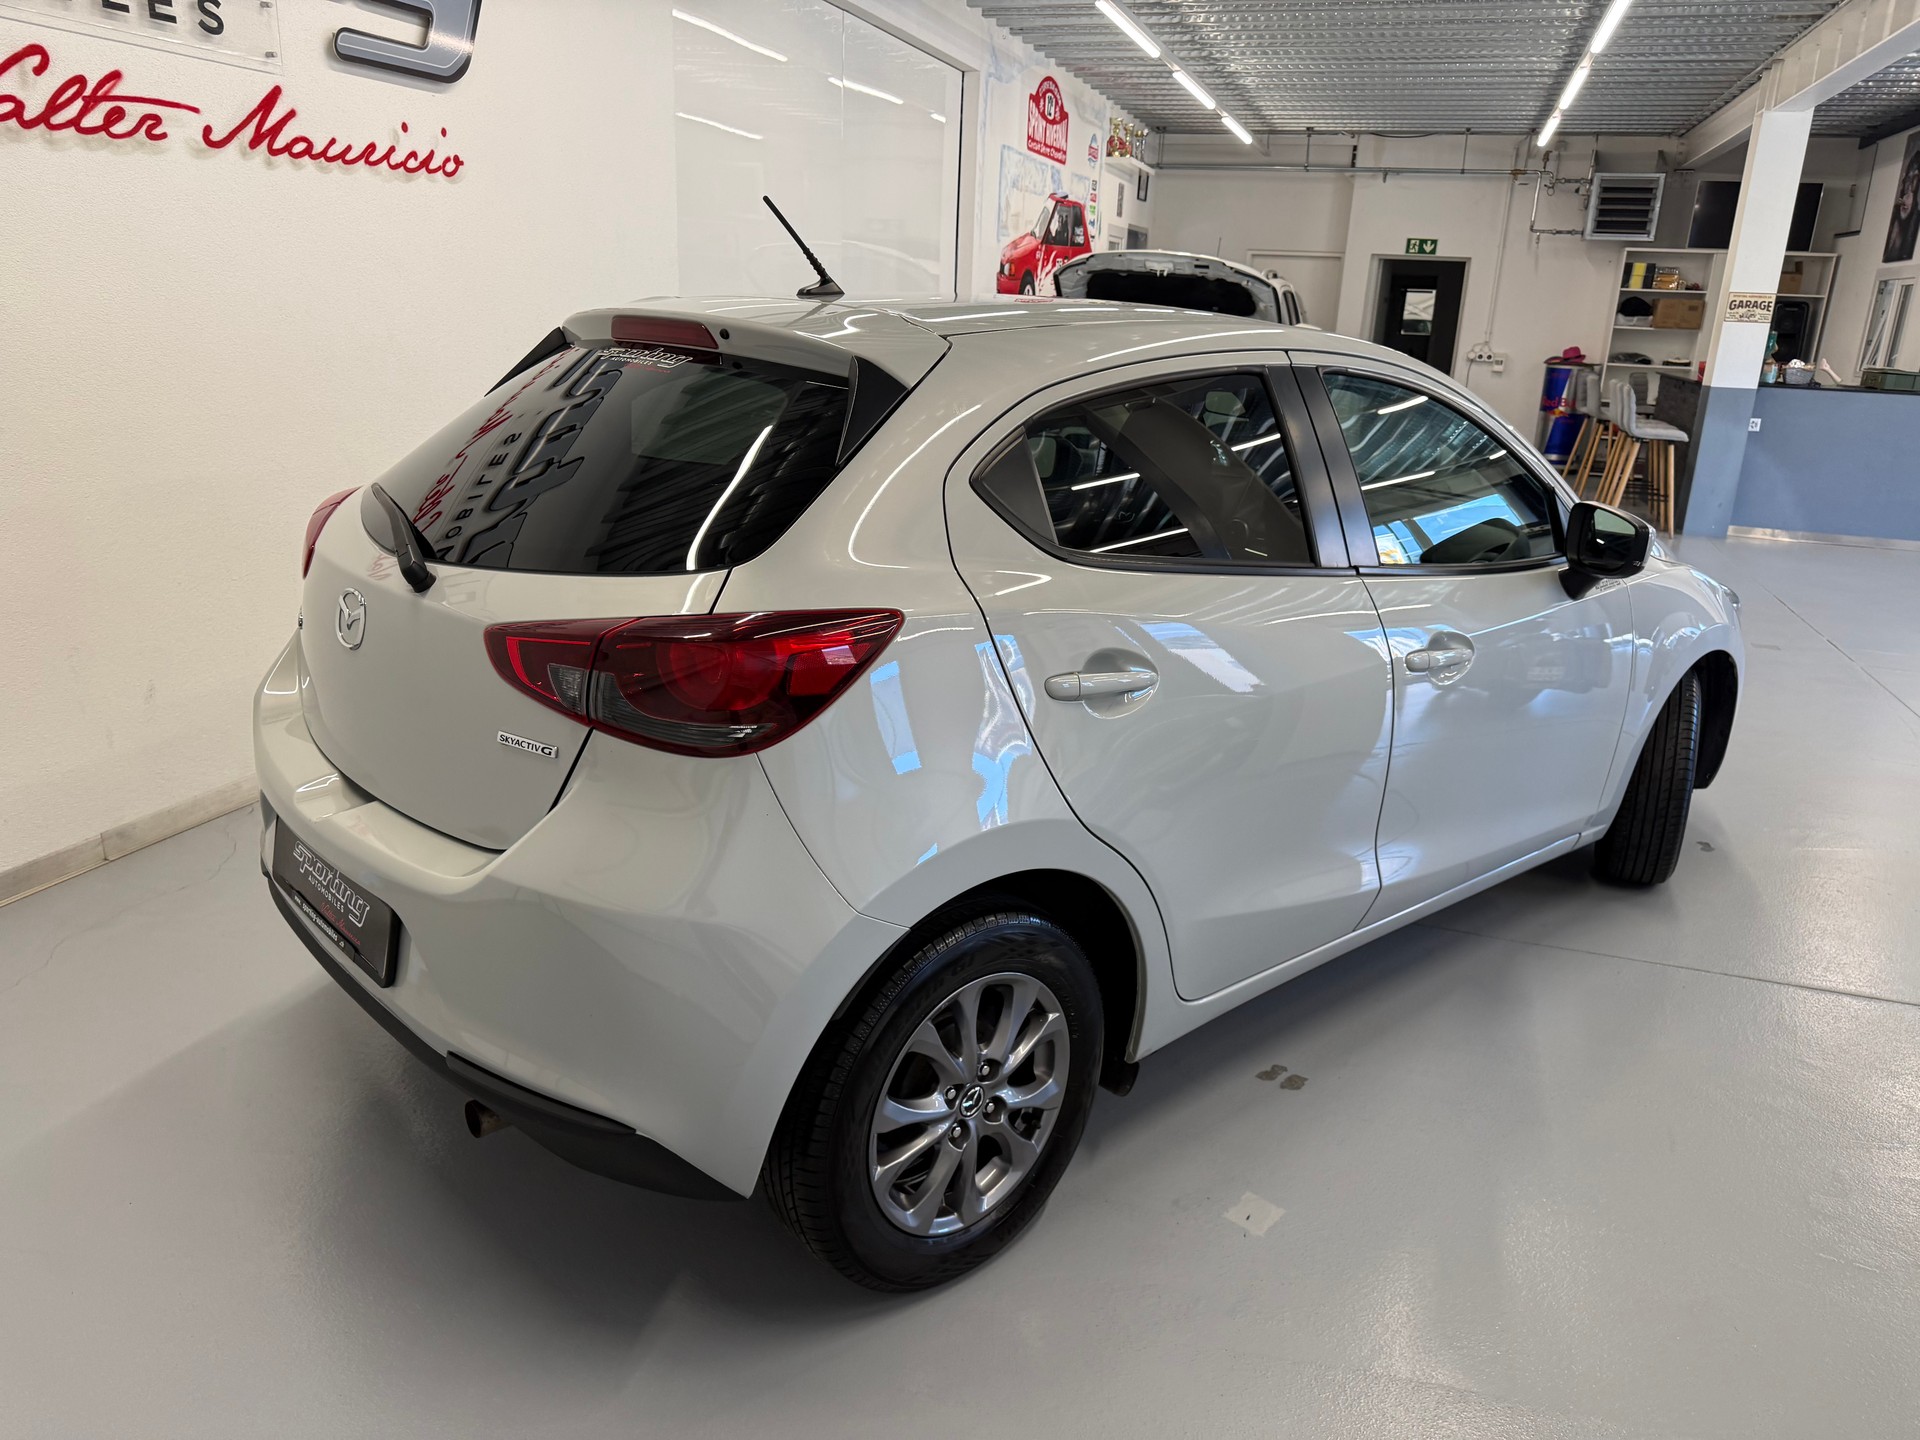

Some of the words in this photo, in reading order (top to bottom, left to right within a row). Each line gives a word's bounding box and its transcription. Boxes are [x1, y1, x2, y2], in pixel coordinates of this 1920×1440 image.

[202, 84, 465, 178] Mauricio
[1728, 299, 1773, 313] GARAGE
[293, 840, 371, 928] sporting
[308, 875, 345, 913] AUTOMOBILES
